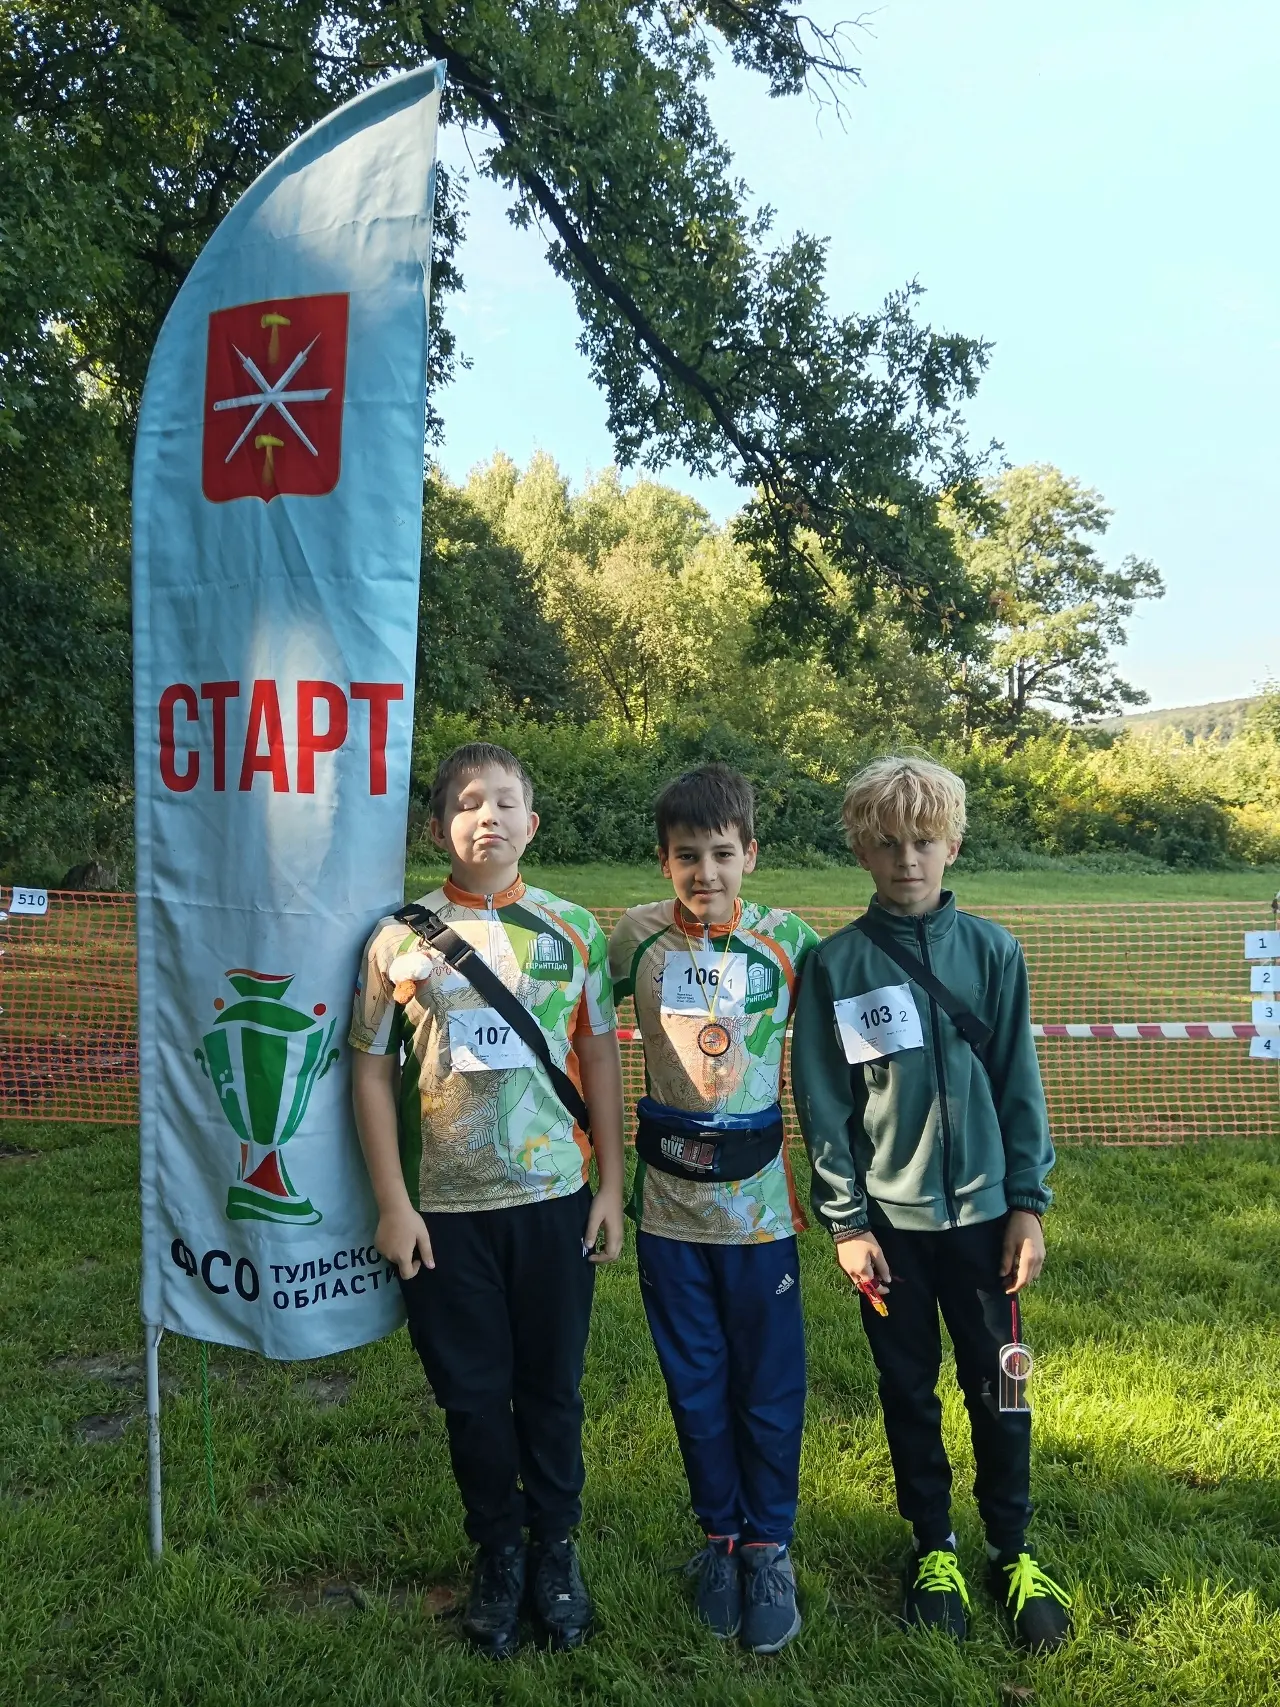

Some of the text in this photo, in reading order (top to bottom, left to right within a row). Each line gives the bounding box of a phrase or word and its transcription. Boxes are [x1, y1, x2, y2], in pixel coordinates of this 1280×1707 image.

[158, 679, 404, 796] СТАРТ
[17, 893, 46, 907] 510
[1258, 937, 1268, 949] 1
[684, 967, 733, 990] 106 1
[1262, 972, 1271, 984] 2
[860, 1005, 909, 1030] 103 2
[1264, 1006, 1273, 1018] 3
[474, 1026, 511, 1046] 107
[1263, 1039, 1272, 1050] 4
[660, 1137, 684, 1159] GIVE
[170, 1238, 260, 1303] ФСО
[269, 1244, 383, 1285] ТУЛЬСКО
[775, 1279, 795, 1295] adidas
